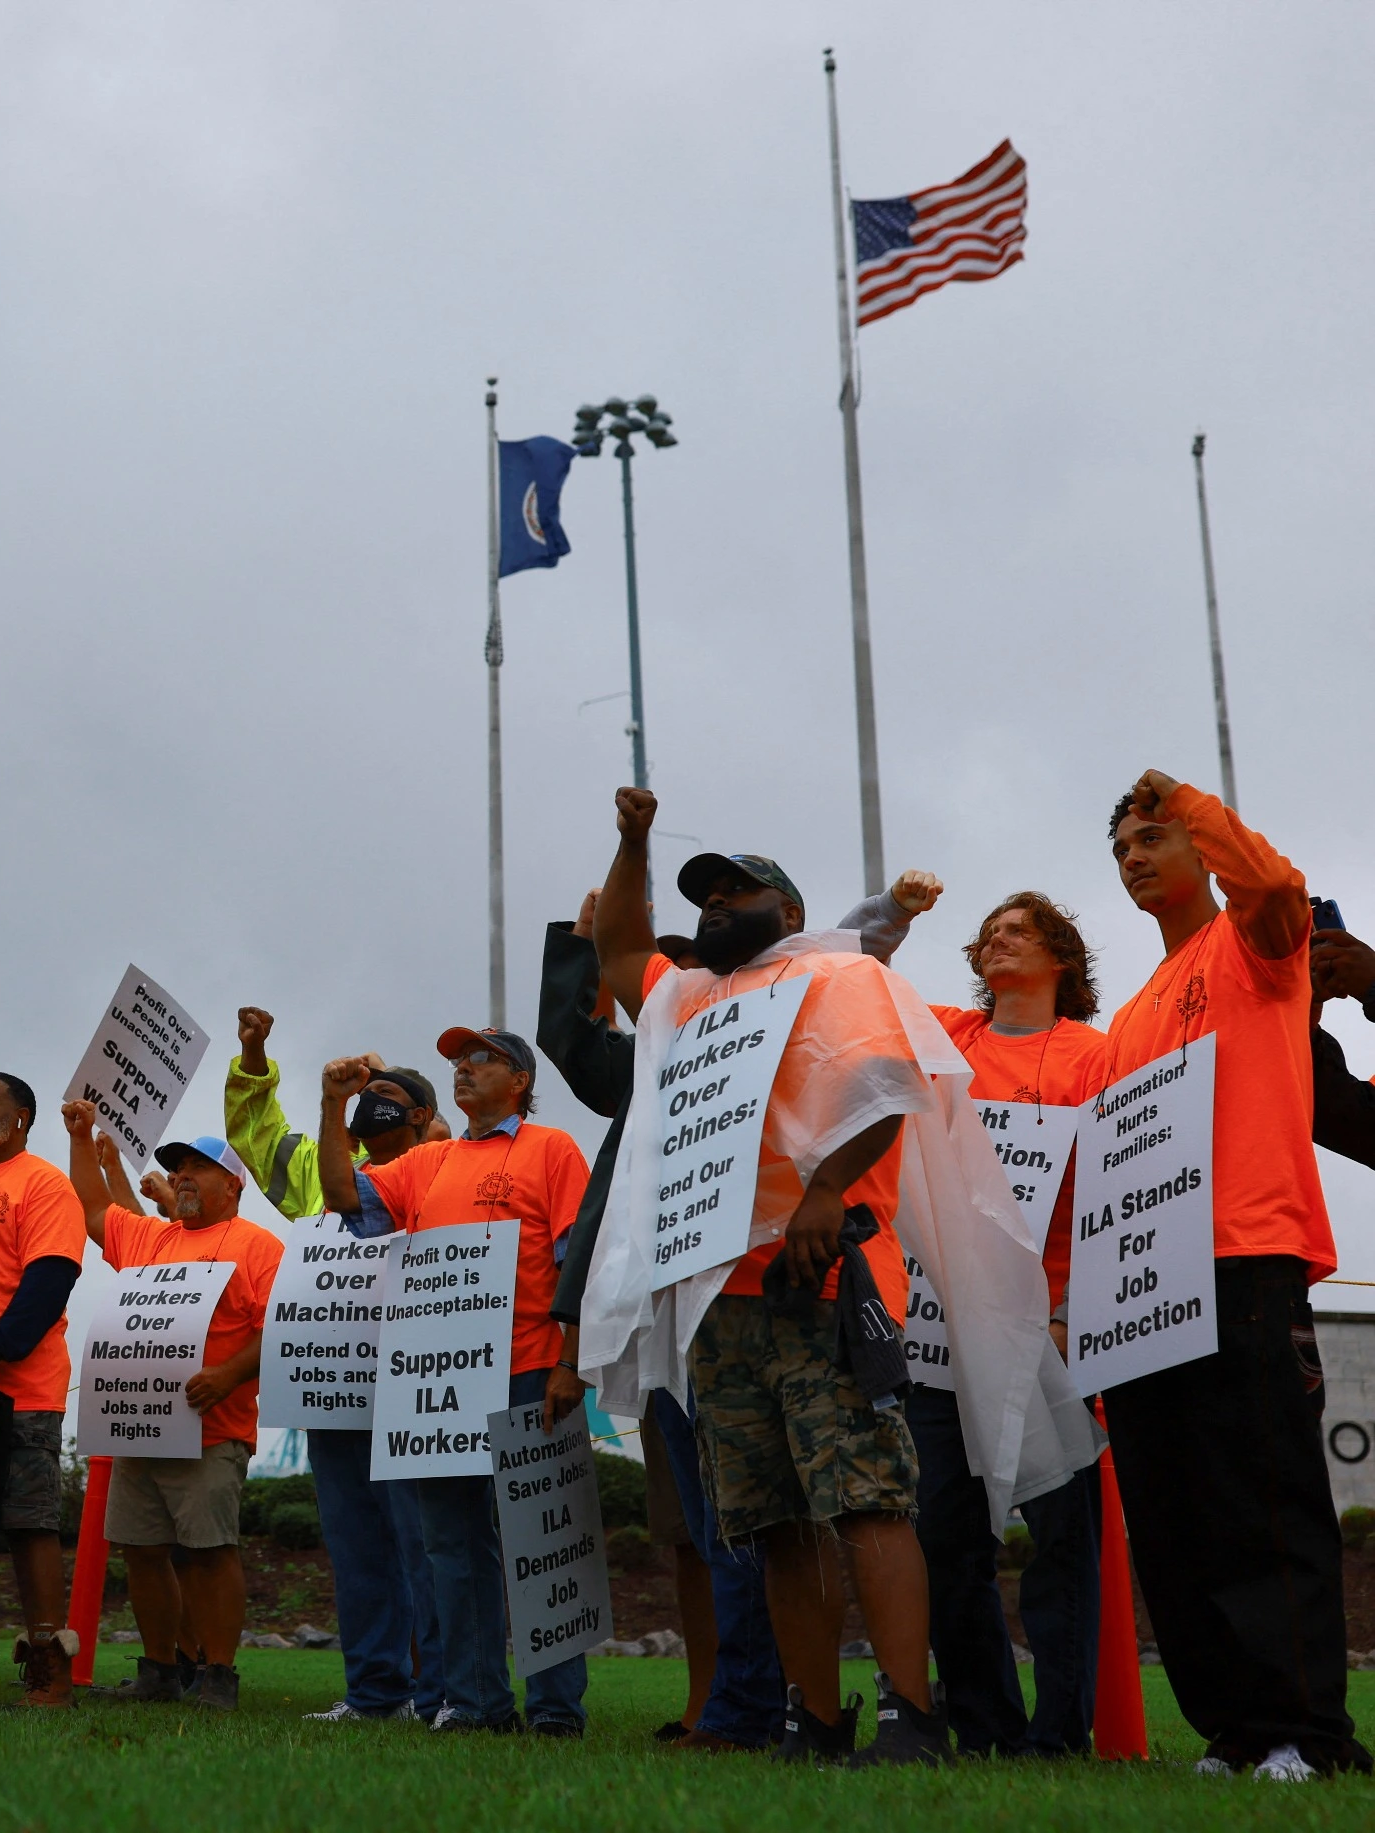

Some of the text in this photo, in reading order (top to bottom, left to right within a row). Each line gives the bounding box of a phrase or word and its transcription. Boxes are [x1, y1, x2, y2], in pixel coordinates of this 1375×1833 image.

[132, 1003, 180, 1055] People is
[135, 985, 192, 1044] Profit Over
[697, 1002, 740, 1039] ILA
[112, 1007, 187, 1085] Unacceptable:
[659, 1028, 766, 1091] Workers
[103, 1040, 168, 1110] Support
[112, 1078, 140, 1115] ILA
[669, 1075, 730, 1117] Over
[1096, 1064, 1185, 1122] Automation
[83, 1083, 147, 1158] Workers
[663, 1099, 758, 1156] chines:
[1117, 1104, 1158, 1137] Hurts
[1103, 1125, 1172, 1172] Families:
[700, 1156, 734, 1184] Our
[656, 1189, 720, 1233] bs and
[1080, 1167, 1202, 1242] ILA Stands
[303, 1242, 389, 1263] Worker
[402, 1244, 490, 1269] Profit Over
[655, 1230, 702, 1264] ights
[1119, 1228, 1156, 1262] For
[154, 1267, 187, 1283] ILA
[316, 1271, 376, 1291] Over
[405, 1269, 480, 1293] People is
[1116, 1267, 1158, 1304] Job
[119, 1290, 202, 1306] Workers
[276, 1300, 382, 1322] Machine
[386, 1292, 508, 1321] Unacceptable:
[126, 1314, 174, 1330] Over
[1078, 1297, 1202, 1361] Protection
[91, 1341, 196, 1359] Machines:
[281, 1342, 379, 1358] Defend Ou
[390, 1343, 493, 1378] Support
[95, 1378, 181, 1392] Defend Our
[290, 1367, 336, 1383] Jobs
[101, 1400, 172, 1415] Jobs and
[302, 1391, 367, 1411] Rights
[416, 1386, 459, 1414] ILA
[110, 1423, 160, 1440] Rights
[388, 1428, 491, 1457] Workers
[499, 1428, 586, 1472] Automation,
[508, 1461, 588, 1502] Save Jobs:
[542, 1505, 571, 1534] ILA
[515, 1532, 594, 1581] Demands
[547, 1578, 578, 1608] Job
[531, 1607, 599, 1652] Security
